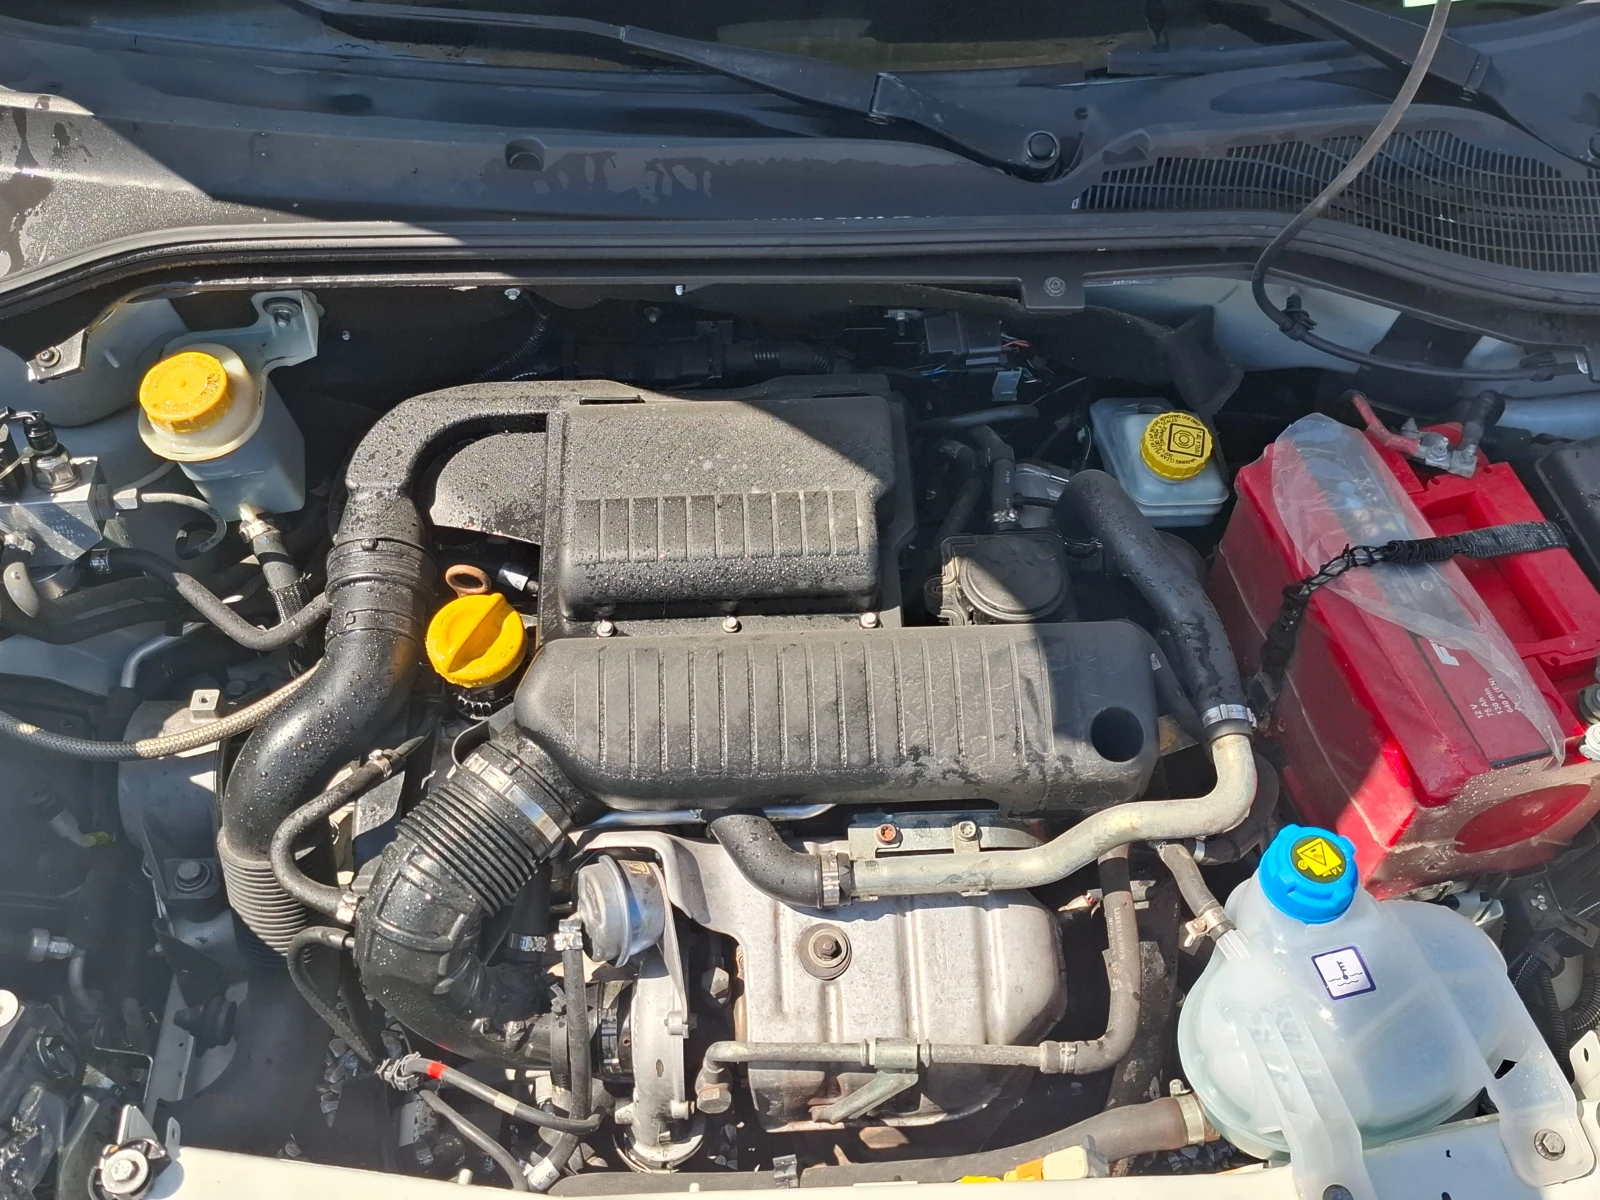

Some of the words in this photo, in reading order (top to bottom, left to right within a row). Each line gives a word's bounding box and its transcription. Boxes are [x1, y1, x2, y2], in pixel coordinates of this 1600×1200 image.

[1485, 688, 1495, 701] min
[1479, 697, 1488, 707] Ah
[1492, 702, 1503, 714] 130
[1502, 701, 1513, 713] 640
[1474, 710, 1483, 719] 12
[1484, 708, 1494, 717] 75
[1114, 906, 1122, 931] TURKEY
